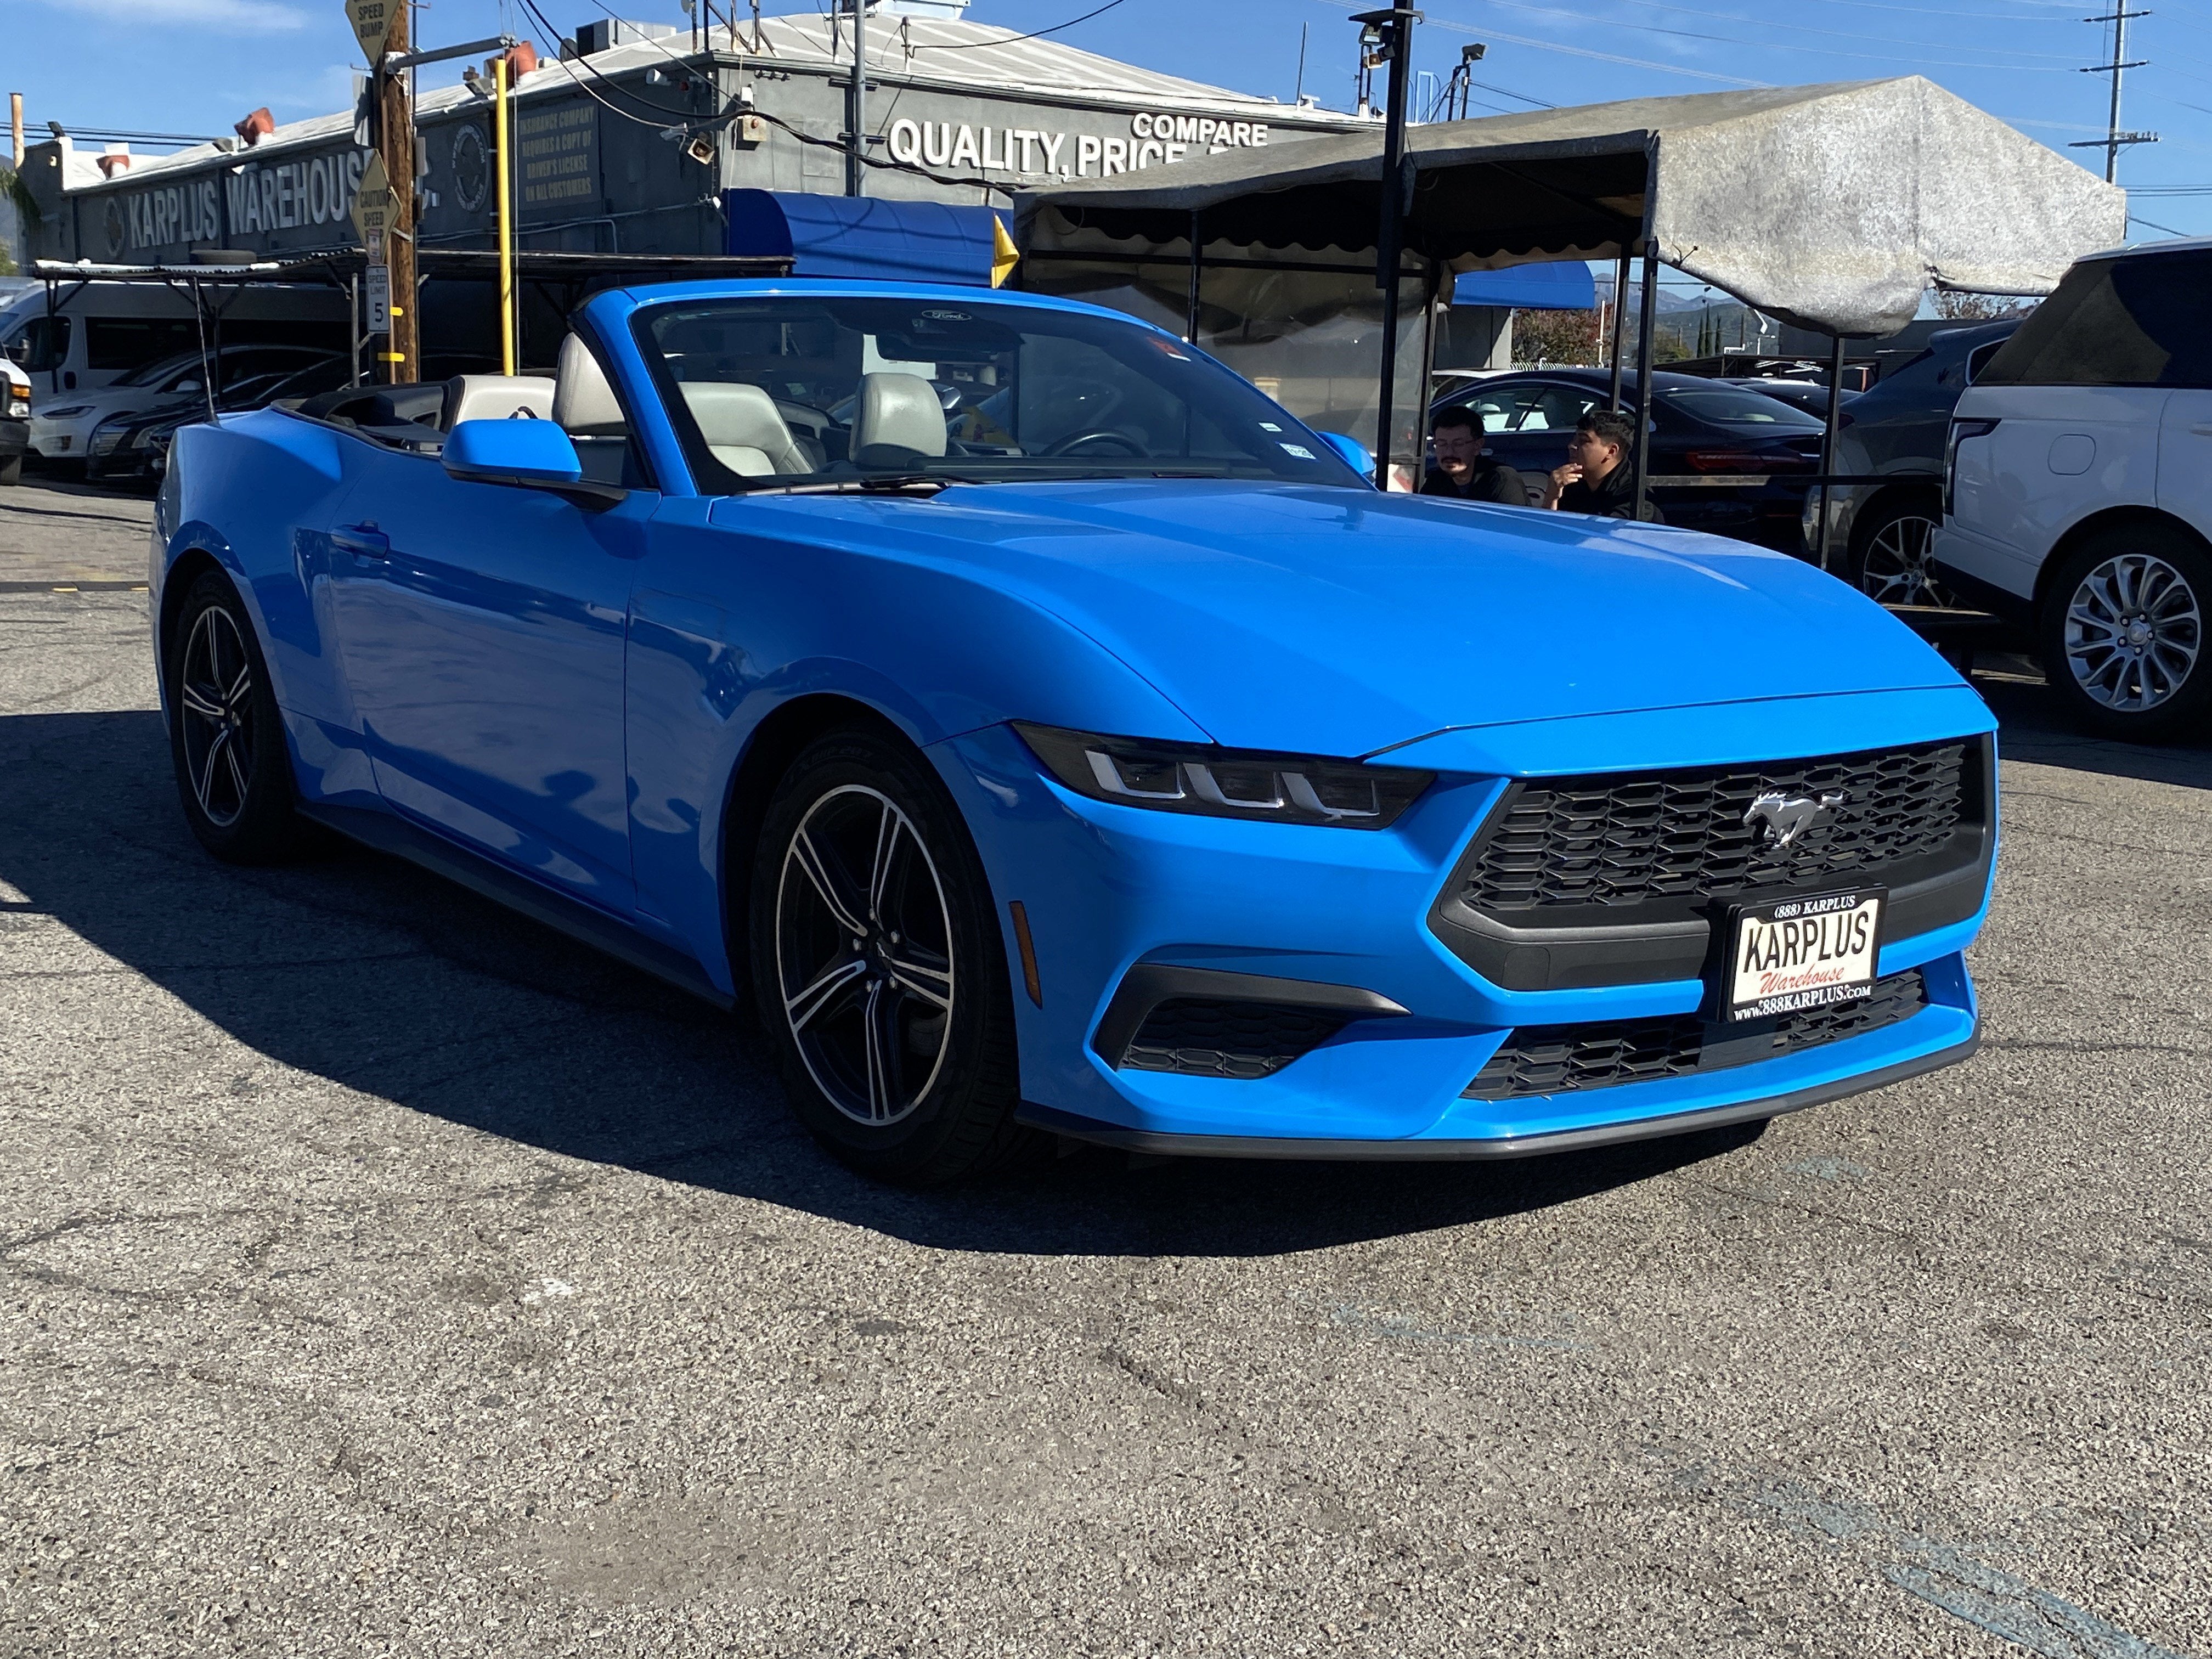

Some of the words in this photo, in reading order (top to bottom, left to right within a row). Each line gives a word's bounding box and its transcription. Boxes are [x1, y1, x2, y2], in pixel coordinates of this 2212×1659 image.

[358, 3, 383, 20] SPEED
[360, 21, 383, 38] BUMP
[520, 113, 558, 135] INSURANCE
[559, 105, 594, 128] COMPANY
[1133, 112, 1268, 147] COMPARE
[555, 136, 560, 151] A
[562, 132, 581, 150] COPY
[583, 130, 592, 147] OF
[890, 119, 1069, 182] QUALITY,
[558, 154, 588, 174] LICENSE
[360, 189, 390, 208] CAUTION
[549, 177, 591, 199] CUSTOMERS
[128, 180, 217, 249] KARPLUS
[225, 149, 376, 235] WAREHOUS
[364, 211, 383, 227] SPEED
[369, 275, 387, 283] SPEED
[370, 286, 385, 295] LIMIT
[375, 303, 383, 323] 5
[1774, 904, 1801, 918] (888)
[1803, 895, 1855, 915] KARPLUS
[1743, 910, 1869, 973] KARPLUS
[1759, 963, 1844, 994] Warehouse
